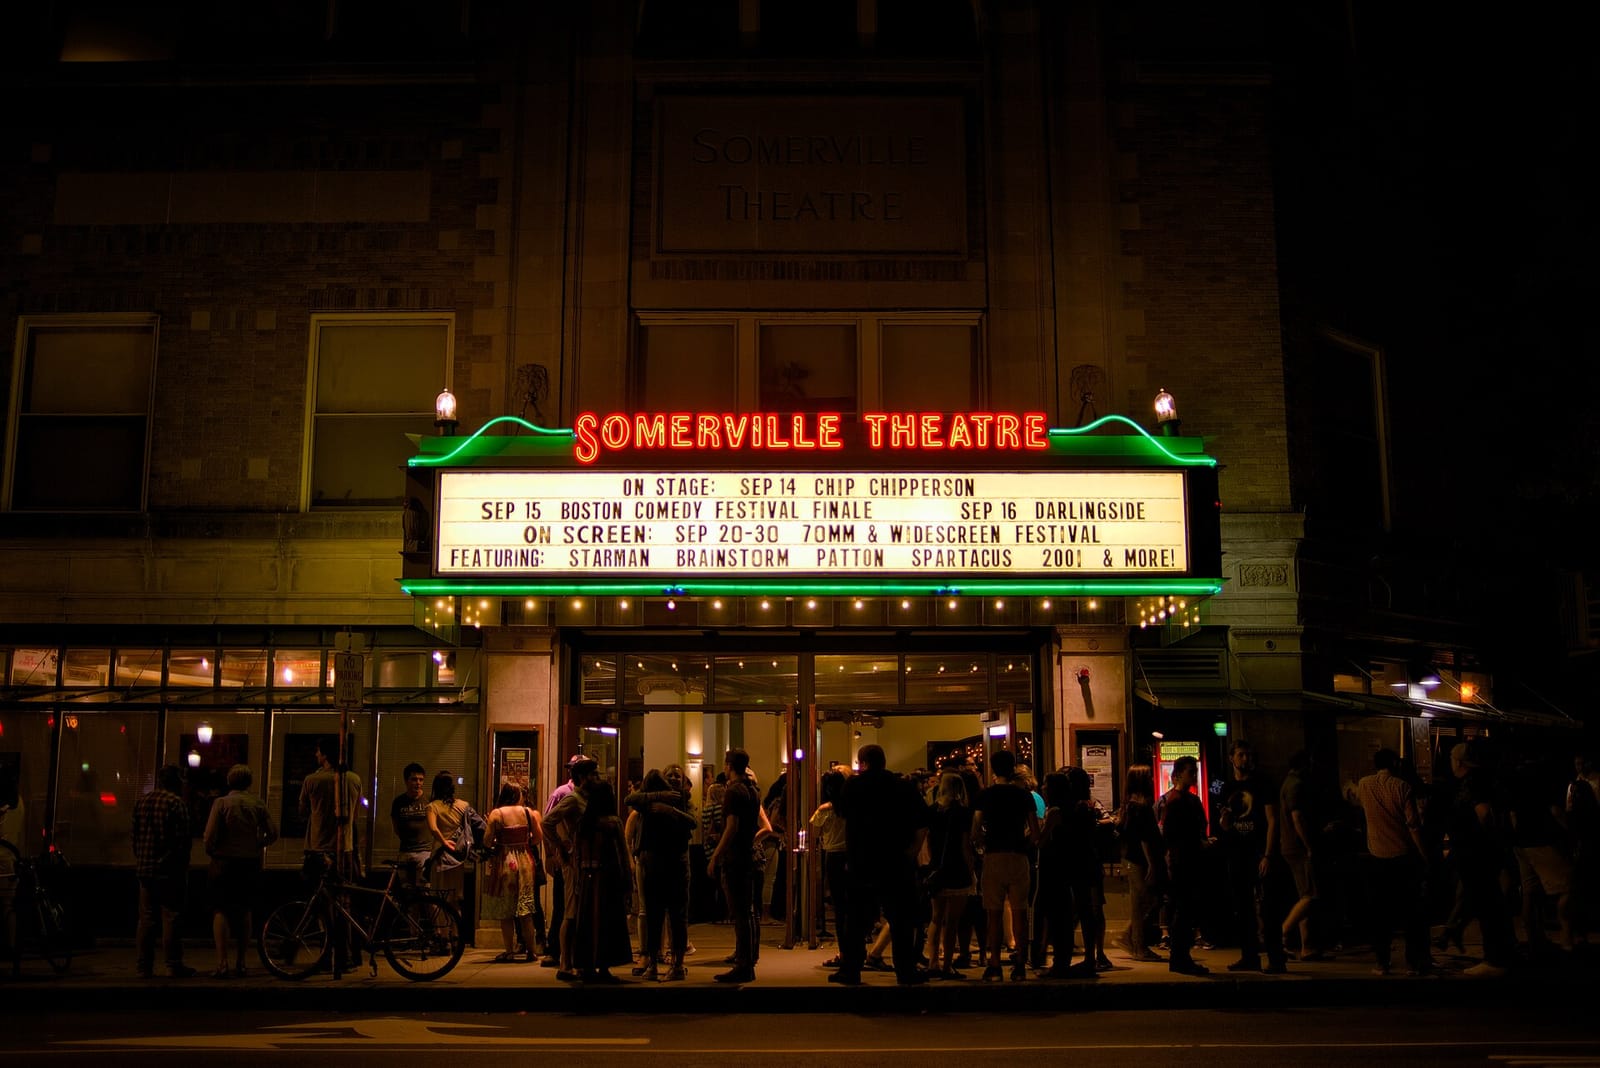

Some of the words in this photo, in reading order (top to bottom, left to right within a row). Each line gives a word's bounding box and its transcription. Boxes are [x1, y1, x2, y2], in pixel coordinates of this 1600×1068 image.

[692, 127, 929, 166] SOMERVILLE
[717, 184, 906, 221] THEATRE
[575, 413, 841, 463] SOMERVILLE
[864, 414, 1048, 448] THEATRE
[622, 477, 644, 497] ON
[655, 477, 716, 497] STAGE:
[740, 477, 773, 497] SEP
[780, 477, 796, 497] 14
[814, 477, 855, 497] CHIP
[869, 477, 975, 497] CHIPPERSON
[481, 501, 516, 520] SEP
[525, 501, 542, 520] 15
[560, 501, 623, 520] BOSTON
[634, 501, 703, 520] COMEDY
[715, 501, 799, 520] FESTIVAL
[813, 501, 872, 520] FINALE
[960, 501, 993, 520] SEP
[1001, 501, 1017, 520] 16
[1035, 501, 1146, 520] DARLINGSIDE
[523, 524, 552, 543] ON
[563, 524, 653, 543] SCREEN:
[675, 524, 708, 543] SEP
[718, 524, 780, 543] 20-30
[802, 524, 855, 543] 70MM
[867, 524, 878, 543] &
[889, 524, 1001, 543] WIDESCREEN
[1015, 524, 1101, 543] FESTIVAL
[450, 548, 545, 567] FEATURING:
[569, 548, 650, 567] STARMAN
[676, 548, 789, 567] BRAINSTORM
[816, 548, 884, 567] PATTON
[911, 548, 1012, 567] SPARTACUS
[1042, 548, 1082, 567] 2001
[1102, 548, 1113, 567] &
[1124, 548, 1175, 567] MORE!
[343, 657, 355, 669] NO
